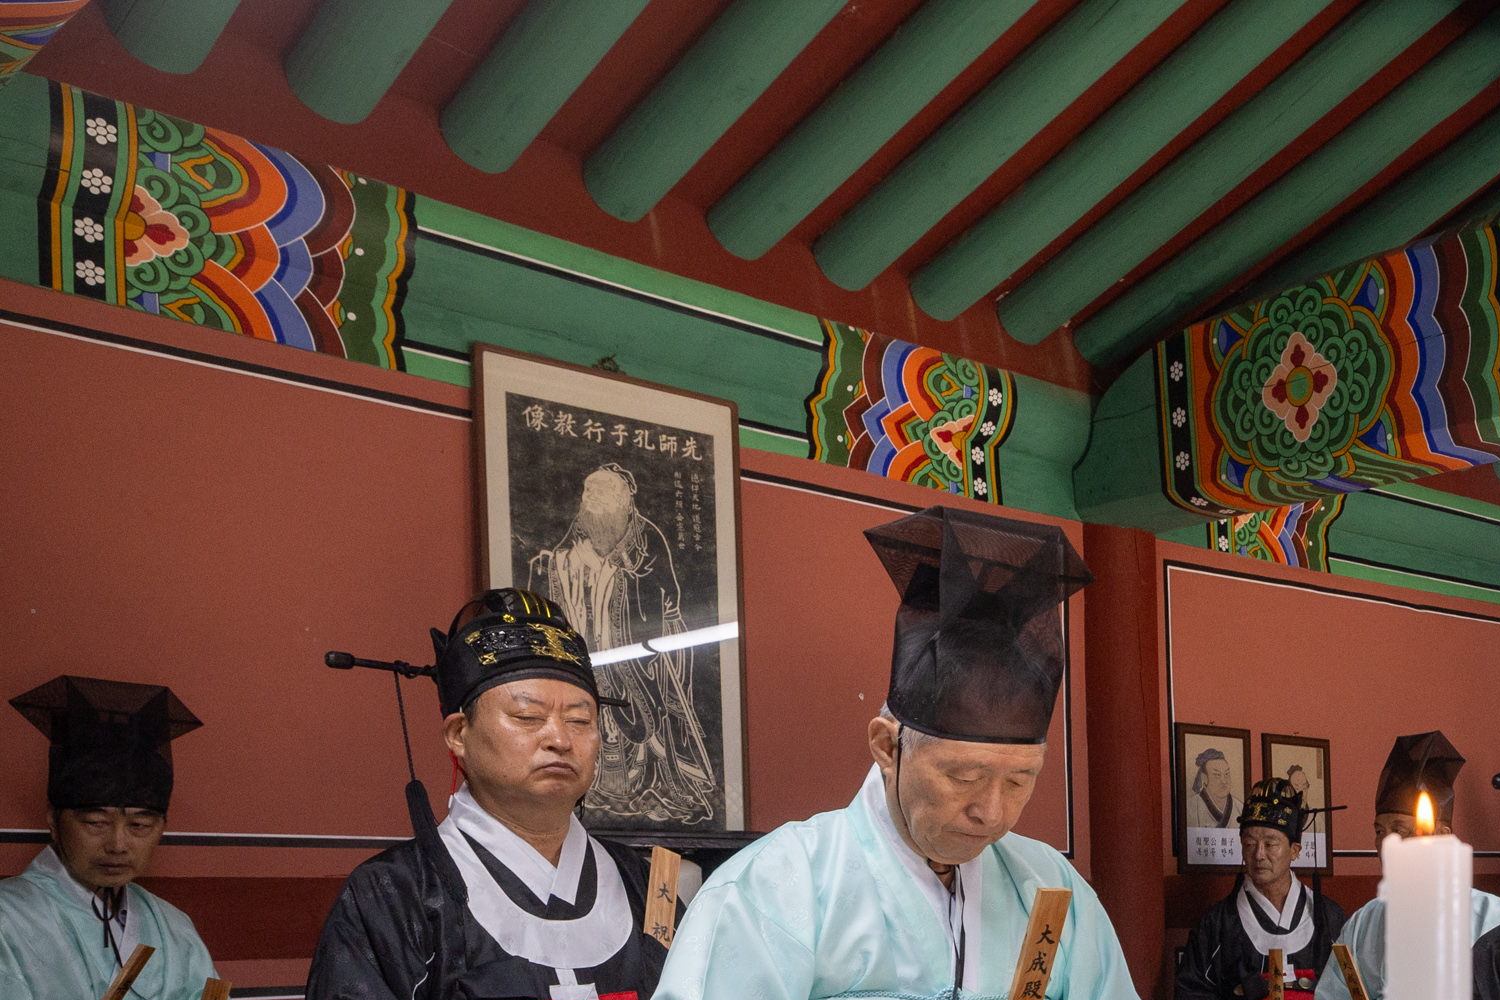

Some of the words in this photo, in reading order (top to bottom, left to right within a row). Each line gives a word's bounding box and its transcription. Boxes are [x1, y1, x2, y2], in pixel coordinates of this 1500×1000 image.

[521, 404, 703, 461] 先師孔子行教像
[652, 882, 673, 942] 大祝
[1020, 924, 1055, 1000] 大成殿
